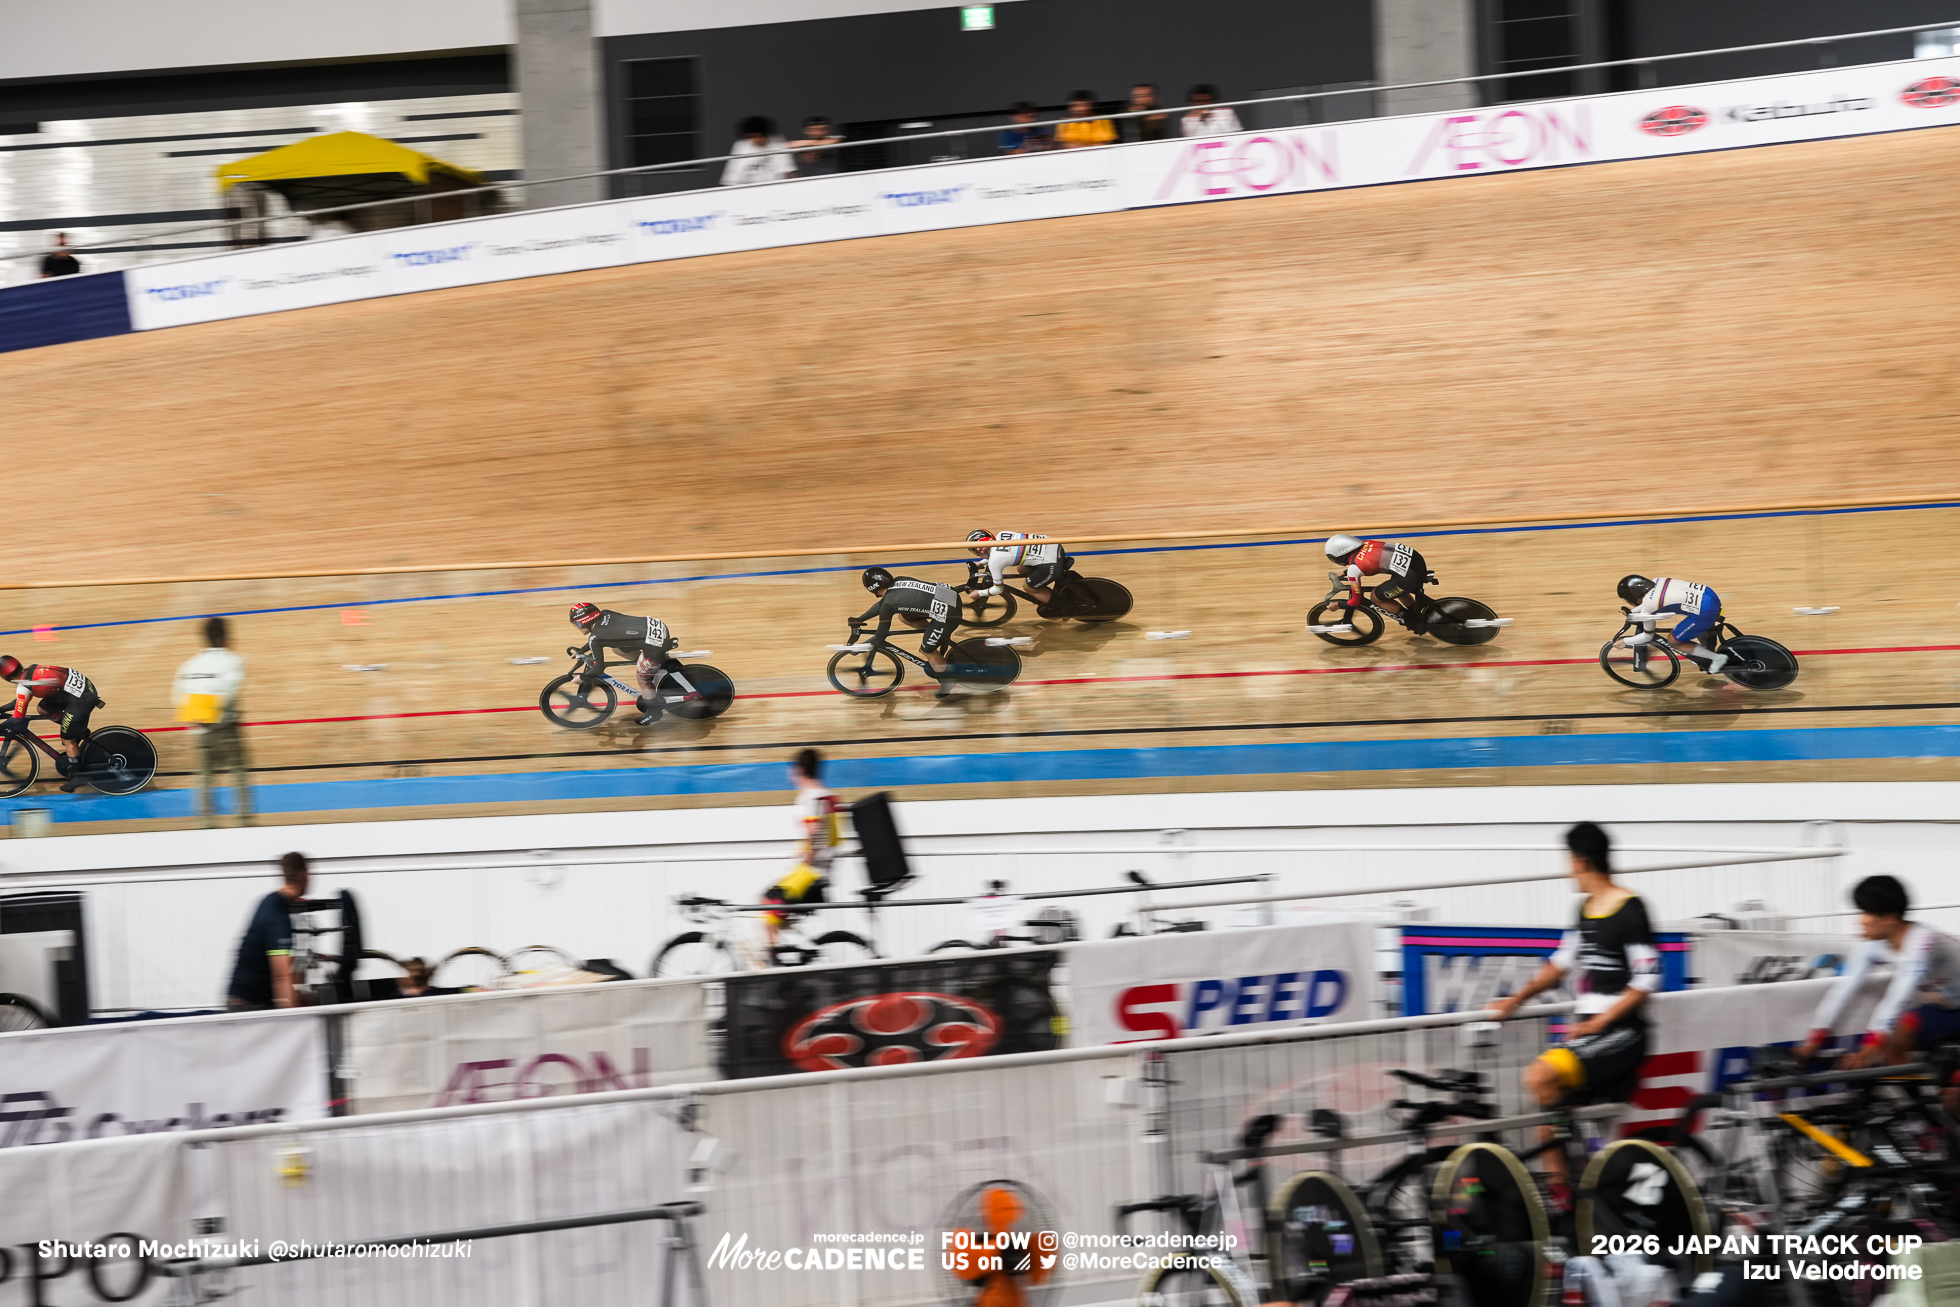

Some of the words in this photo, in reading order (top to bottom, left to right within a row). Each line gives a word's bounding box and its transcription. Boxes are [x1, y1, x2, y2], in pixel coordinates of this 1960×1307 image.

[1393, 553, 1408, 569] 132
[907, 581, 935, 593] ZEALAND
[1684, 591, 1699, 607] 131
[932, 601, 946, 616] 137
[648, 626, 663, 640] 142
[926, 627, 944, 646] NZL
[68, 675, 84, 690] 133
[1106, 969, 1350, 1044] SPEED
